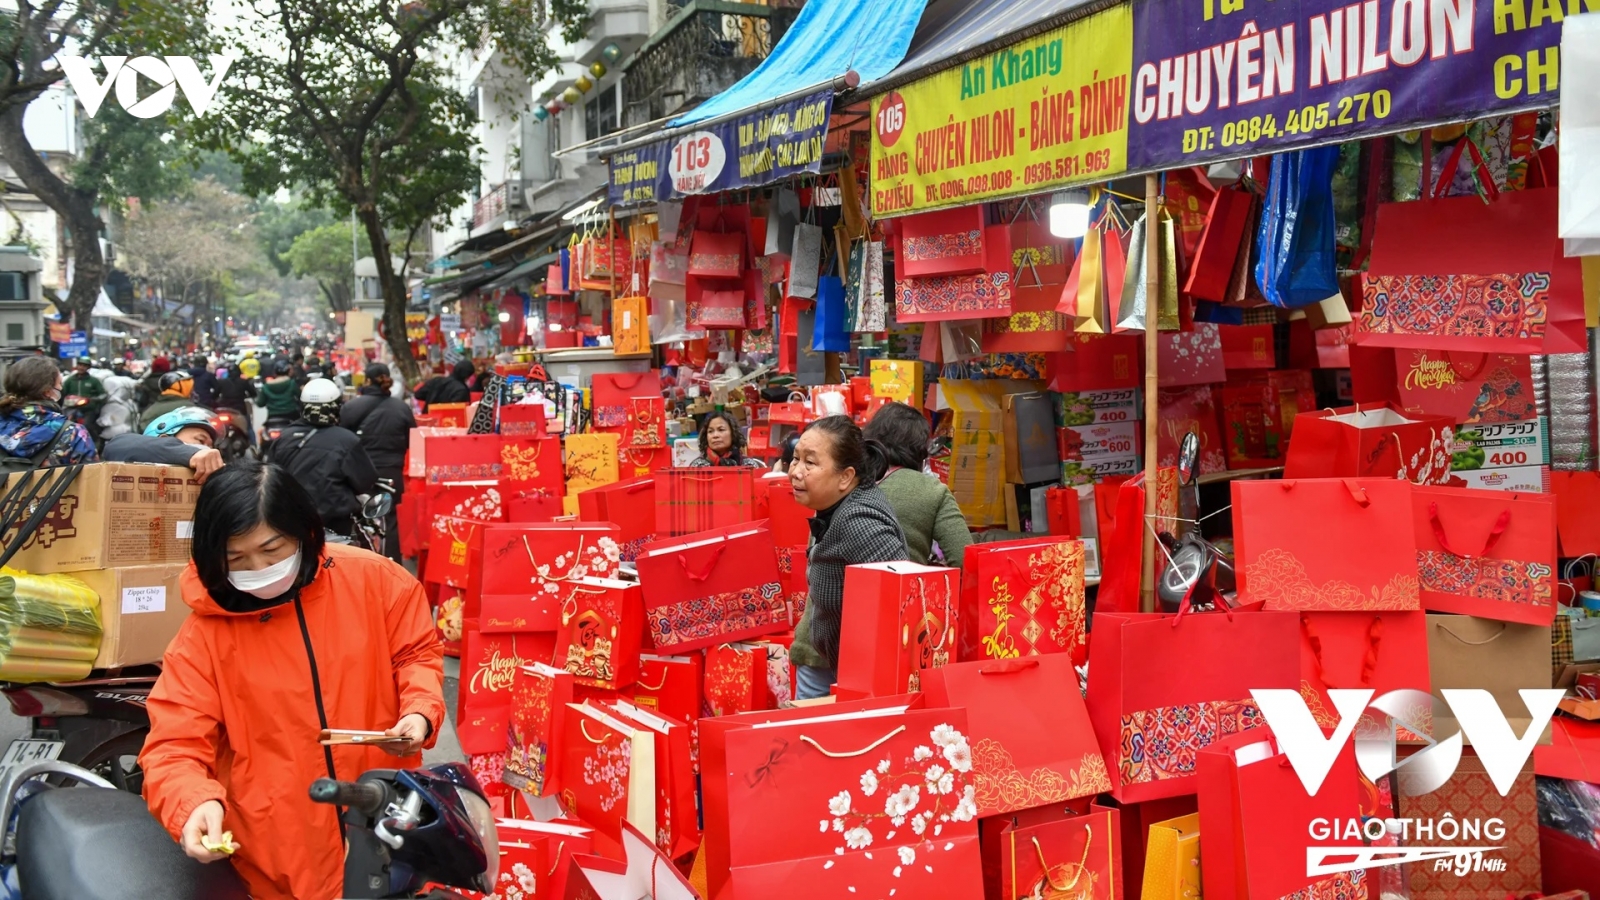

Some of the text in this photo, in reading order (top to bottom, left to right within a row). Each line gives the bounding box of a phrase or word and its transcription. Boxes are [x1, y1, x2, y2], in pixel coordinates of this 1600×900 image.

[960, 38, 1063, 101] An Khang
[1134, 0, 1475, 124] CHUYÊN NILON
[878, 103, 903, 135] 105
[915, 114, 967, 176] CHUYÊN
[969, 107, 1015, 165] NILON
[1030, 86, 1074, 152] BĂNG
[1079, 69, 1127, 140] DÍNH
[1181, 89, 1391, 153] ĐT: 0984.405.270
[674, 136, 711, 173] 103
[877, 151, 908, 181] HÀNG
[939, 169, 1013, 200] 0906.098.008
[1024, 148, 1111, 186] 0936.581.963
[875, 178, 914, 213] CHIẾU
[1100, 411, 1127, 421] 400
[1108, 440, 1131, 453] 600
[1489, 451, 1527, 465] 400
[127, 588, 146, 597] Zipper
